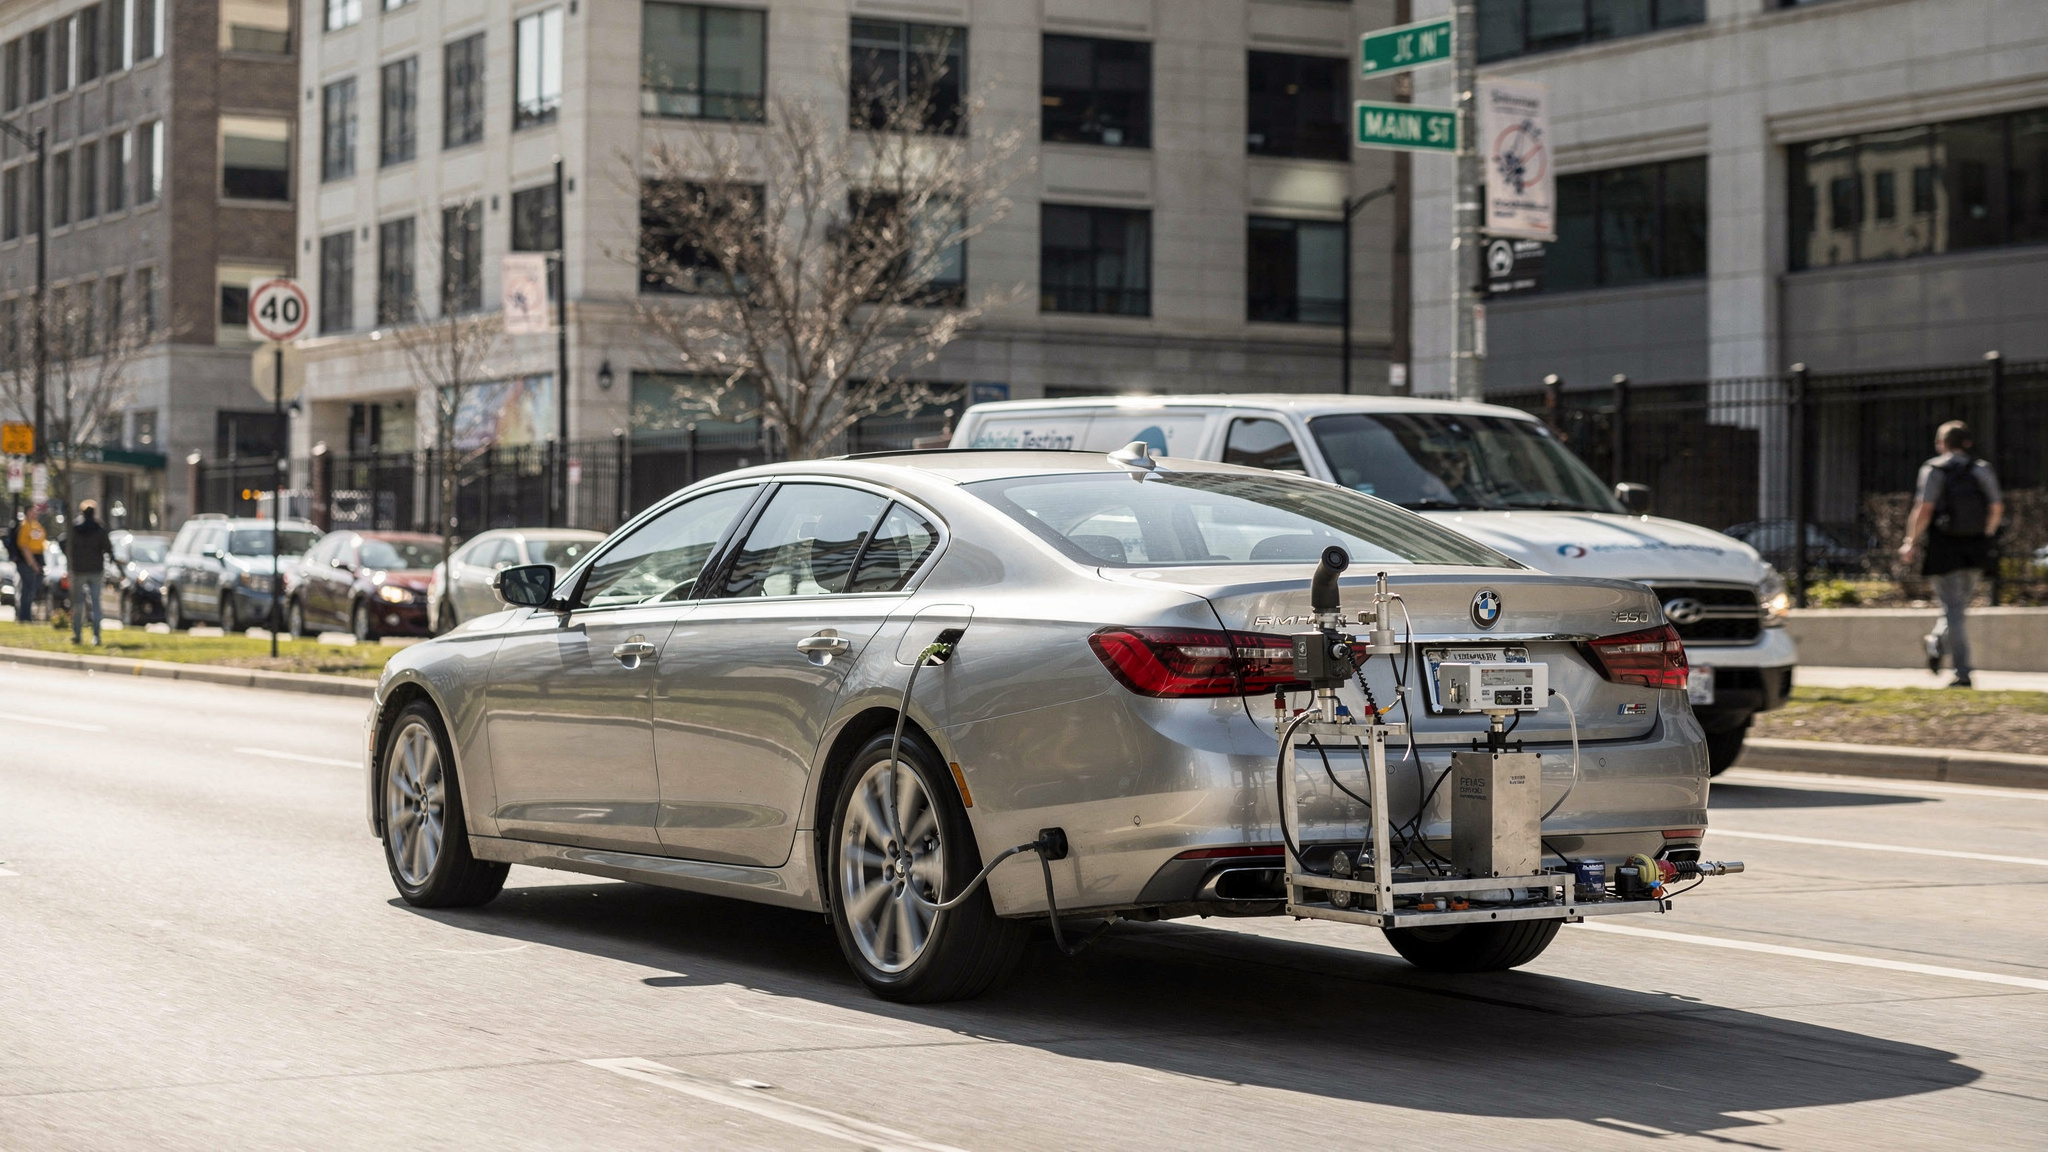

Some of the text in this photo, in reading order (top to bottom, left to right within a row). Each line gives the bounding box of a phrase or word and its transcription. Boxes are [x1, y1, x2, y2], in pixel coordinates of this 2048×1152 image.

[1364, 111, 1452, 143] MAIN ST
[260, 295, 300, 323] 40
[1023, 429, 1074, 449] Testing
